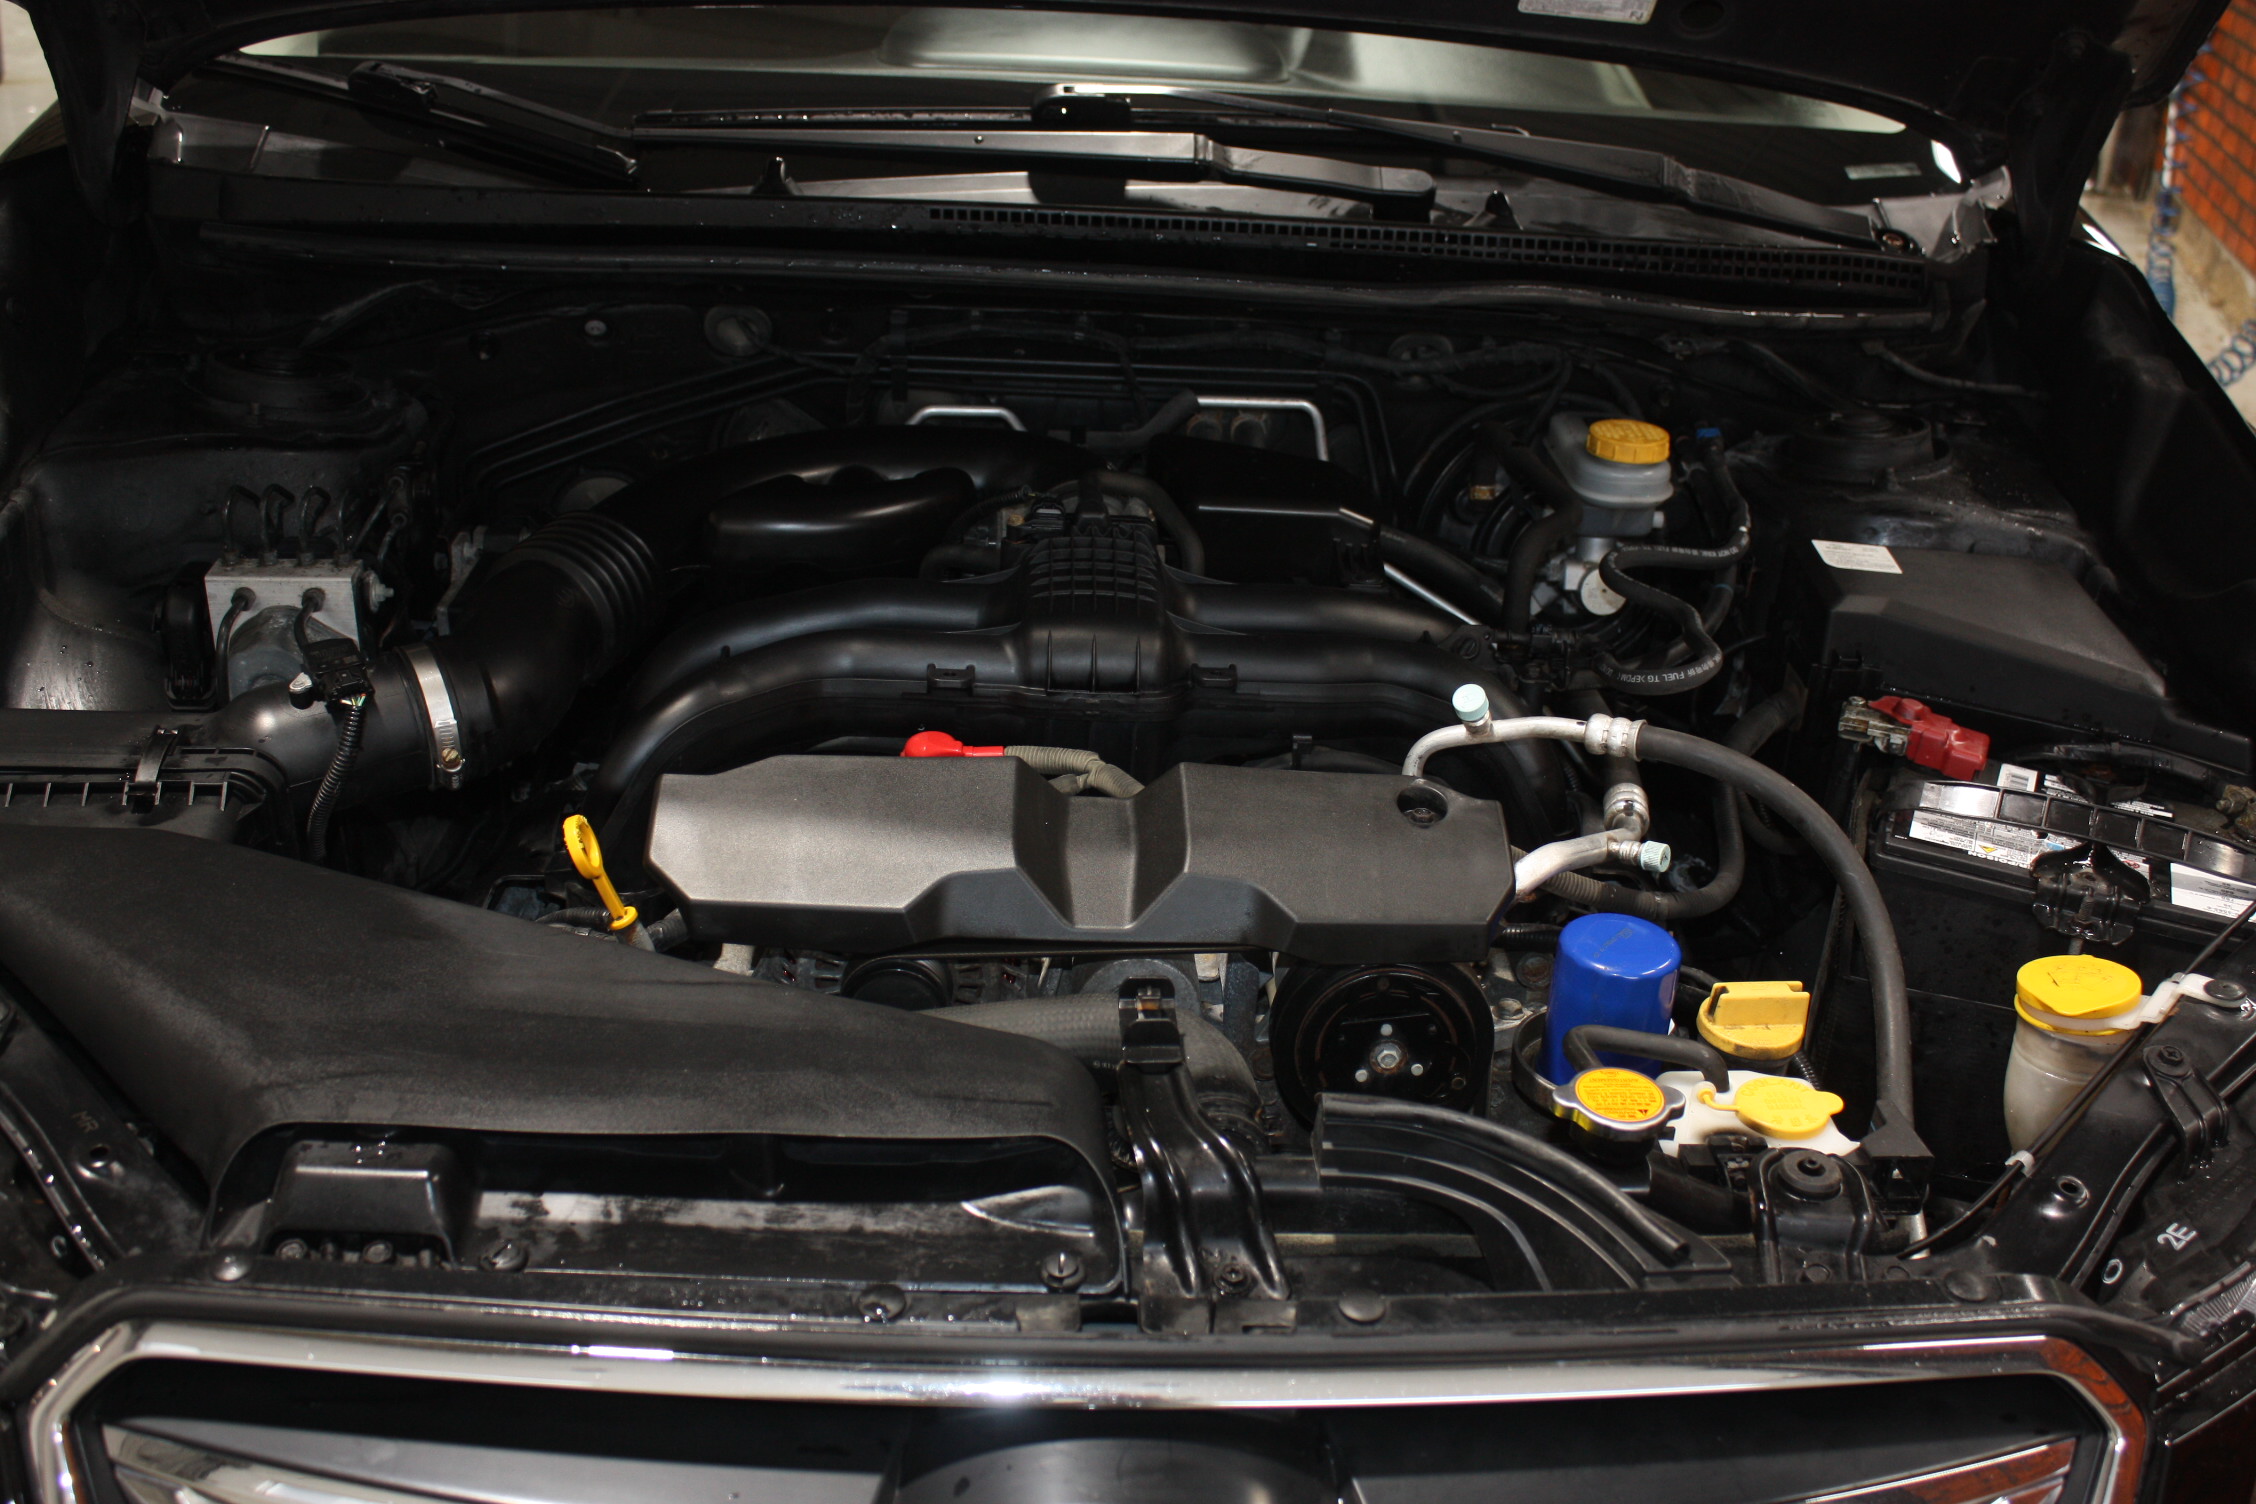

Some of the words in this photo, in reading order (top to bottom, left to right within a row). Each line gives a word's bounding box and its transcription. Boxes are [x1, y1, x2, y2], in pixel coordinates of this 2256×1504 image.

[1647, 673, 1660, 682] TG
[1662, 672, 1685, 682] FUEL
[1741, 1078, 1809, 1096] COOLANT
[2157, 1222, 2197, 1251] 2E
